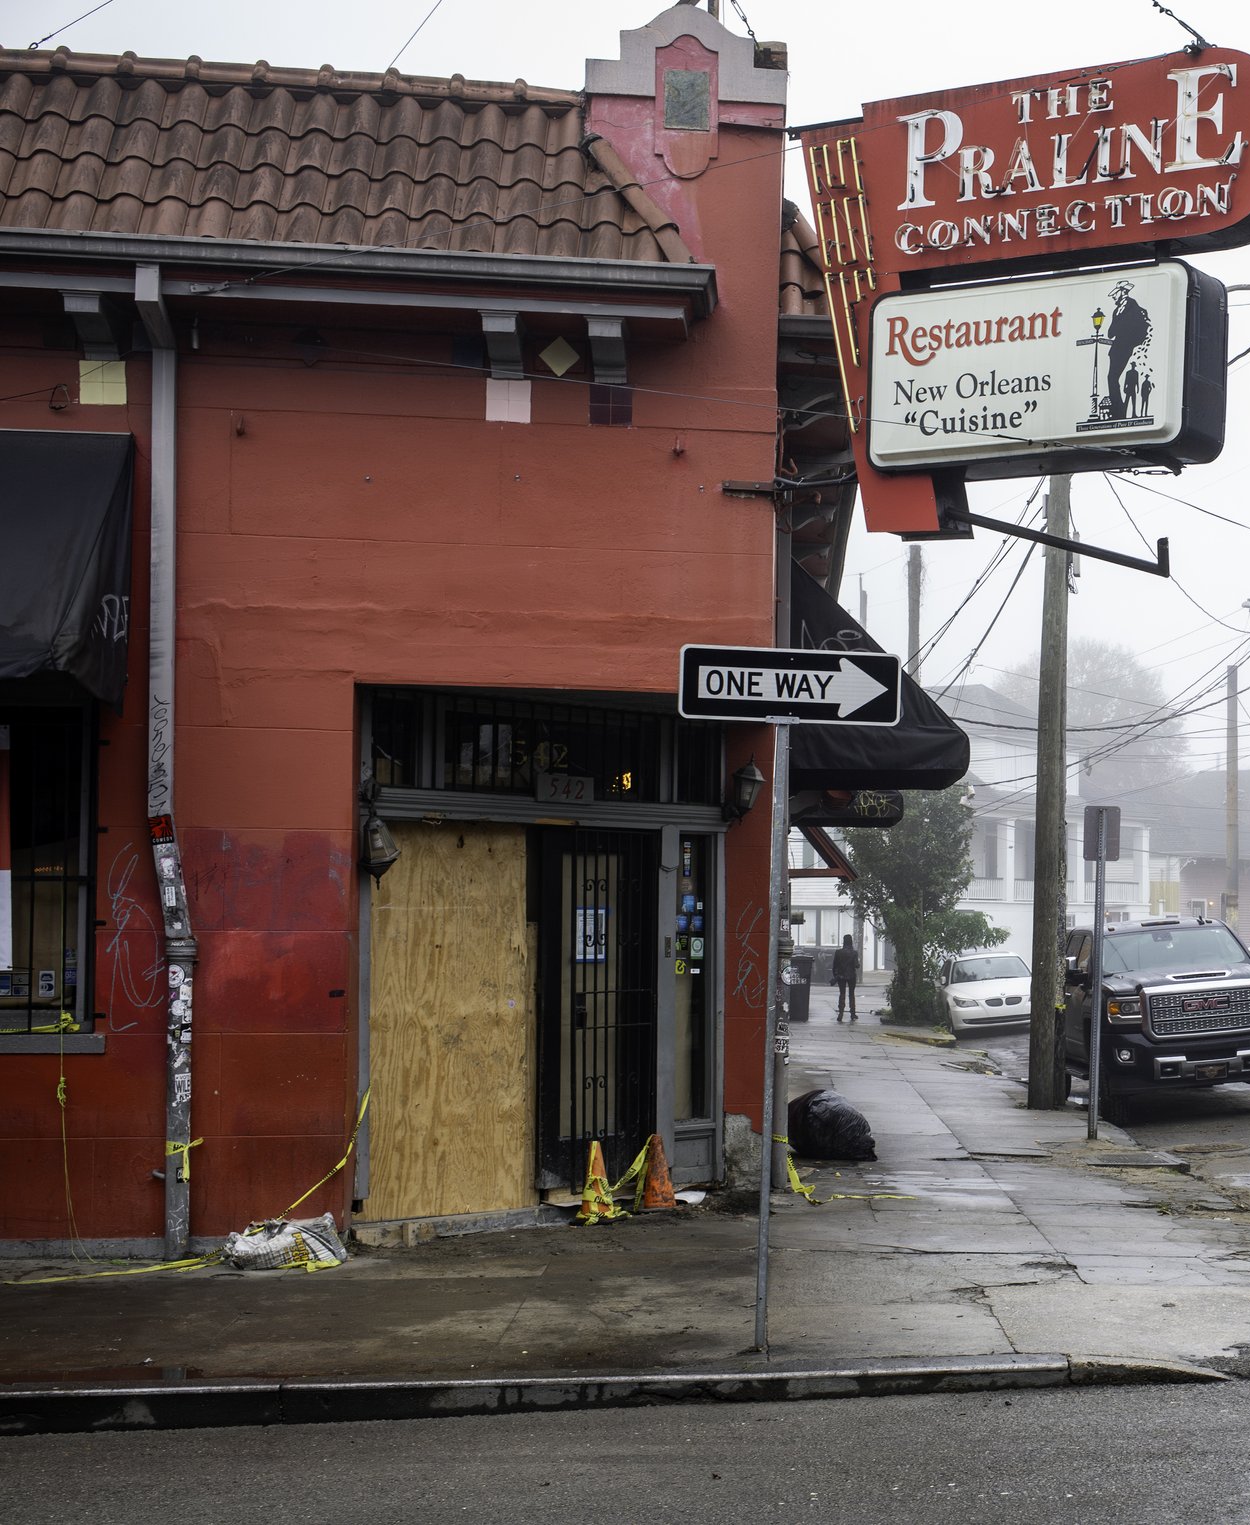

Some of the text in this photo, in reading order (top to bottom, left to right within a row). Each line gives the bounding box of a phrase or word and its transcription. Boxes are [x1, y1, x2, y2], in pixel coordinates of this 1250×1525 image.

[1011, 78, 1114, 124] THE
[897, 63, 1243, 211] PRALINE
[895, 180, 1232, 255] CONNECTION
[885, 306, 1063, 367] Restaurant
[893, 369, 1052, 406] New Orleans
[706, 669, 834, 700] ONE WAY
[549, 777, 585, 800] 542
[152, 835, 174, 843] COMEDY
[1184, 997, 1228, 1011] GMC
